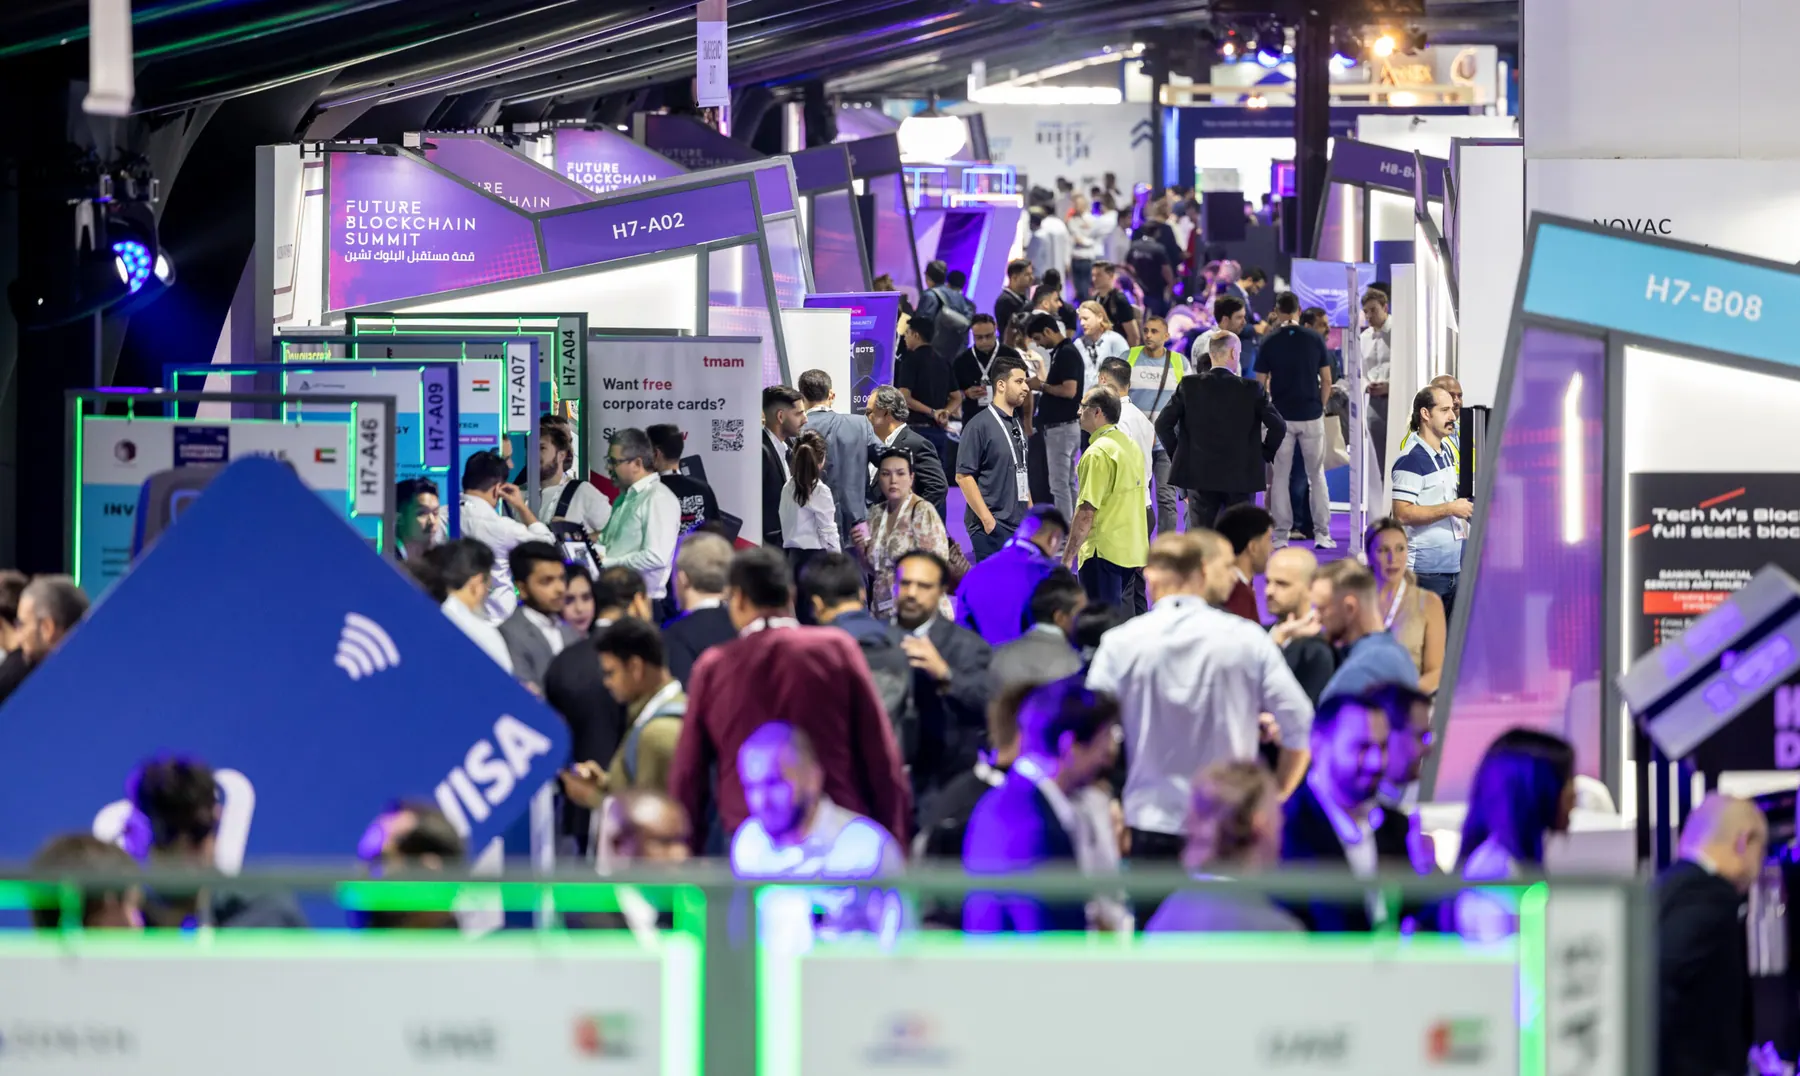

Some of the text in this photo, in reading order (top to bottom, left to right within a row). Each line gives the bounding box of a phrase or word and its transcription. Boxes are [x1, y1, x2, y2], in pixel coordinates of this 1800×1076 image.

[566, 161, 619, 174] FUTURE
[1380, 161, 1415, 180] H8-B
[567, 172, 657, 185] BLOCKCHAIN
[345, 200, 421, 215] FUTURE
[345, 216, 477, 231] BLOCKCHAIN
[611, 212, 686, 240] H7-A02
[345, 232, 421, 247] SUMMIT
[344, 249, 475, 264] قمة مستقبل البلوك تشين
[1645, 273, 1764, 322] H7-B08
[562, 329, 576, 386] H7-A04
[855, 346, 875, 354] BOTS
[703, 355, 745, 368] tmam
[511, 355, 526, 417] H7-A07
[603, 377, 673, 391] Want free
[603, 397, 726, 413] corporate cards?
[428, 382, 444, 452] H7-A09
[360, 418, 379, 496] H7-A46
[1652, 507, 1800, 523] Tech M's Bloc
[1652, 523, 1687, 539] full
[1690, 523, 1752, 539] stack
